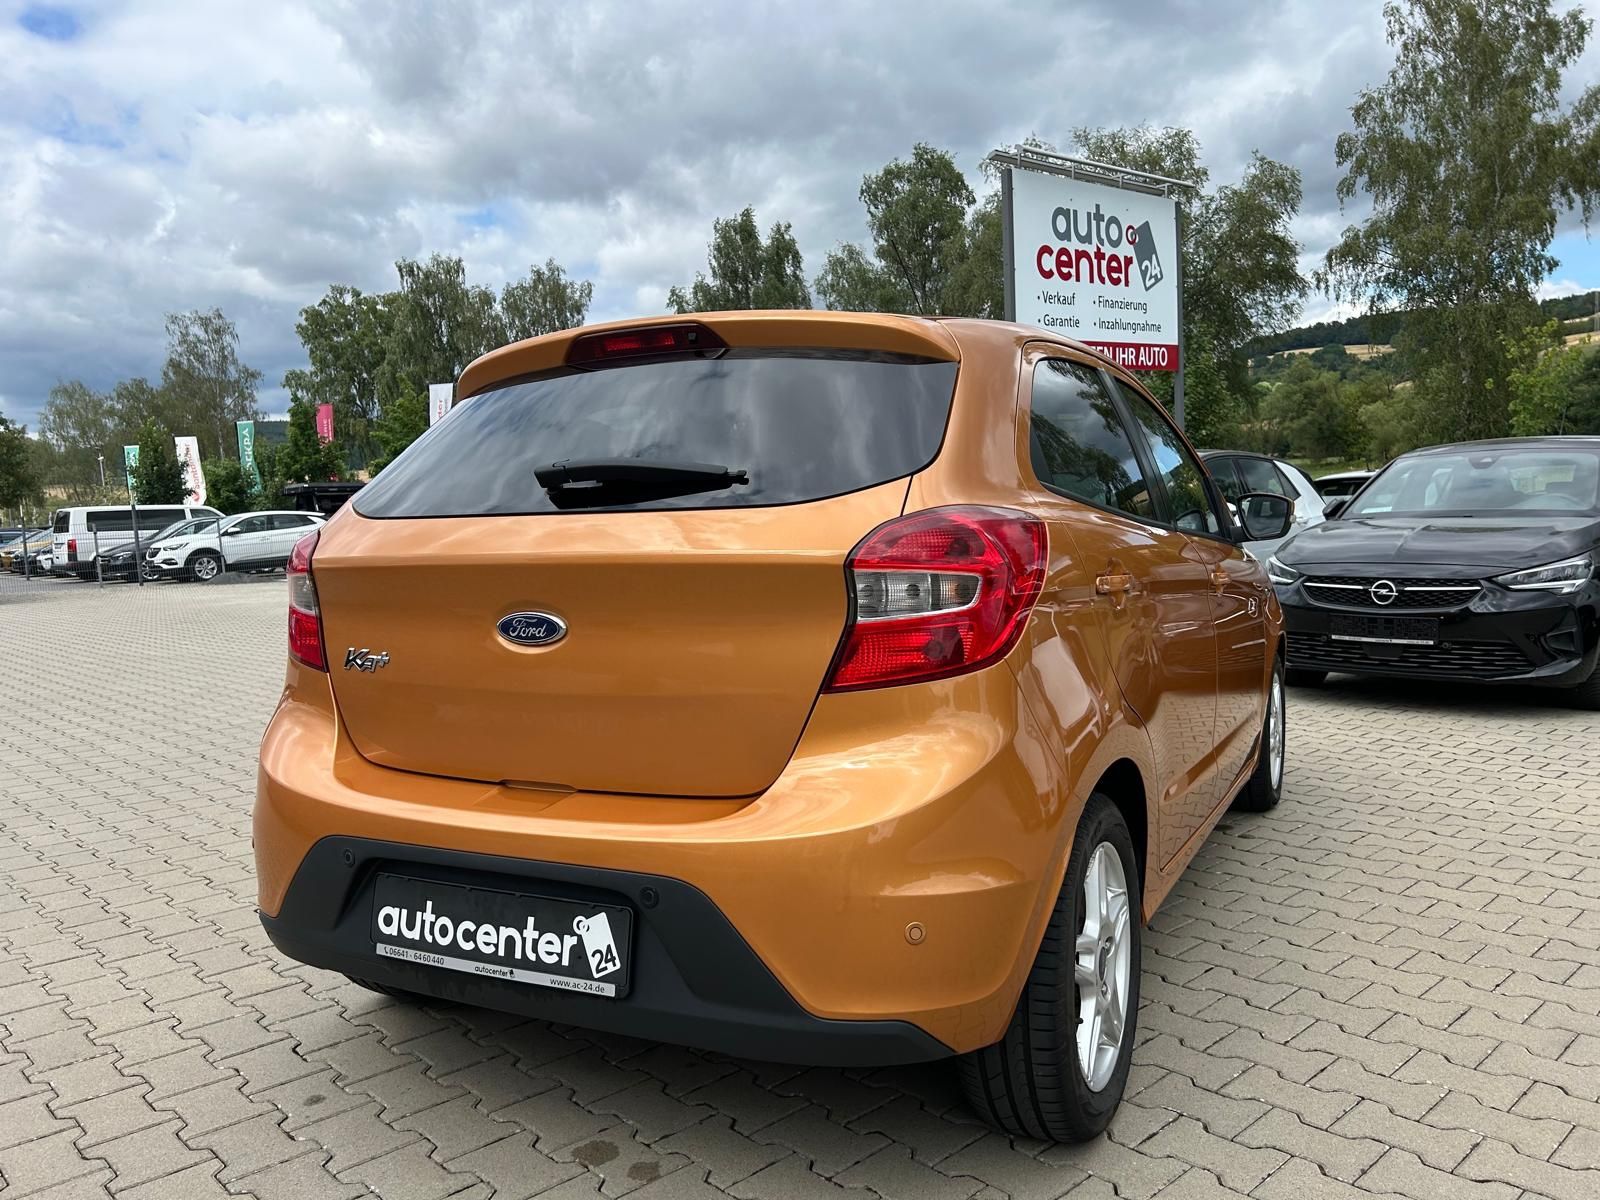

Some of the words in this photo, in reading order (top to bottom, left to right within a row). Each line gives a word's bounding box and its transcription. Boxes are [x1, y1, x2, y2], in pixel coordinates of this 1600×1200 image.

[1051, 203, 1123, 248] auto
[1036, 244, 1133, 287] center
[1141, 254, 1161, 286] 24
[1042, 291, 1076, 306] Verkauf
[1098, 296, 1148, 314] Finanzierung
[1043, 314, 1080, 328] Garantie
[1098, 317, 1162, 334] Inzahlungnahme
[1115, 347, 1136, 366] IHR
[1138, 346, 1168, 366] AUTO
[508, 617, 547, 639] Ford
[377, 900, 578, 967] autocenter
[591, 944, 617, 975] 24
[474, 965, 508, 977] autocenter
[550, 978, 605, 993] www.ac-24.de
